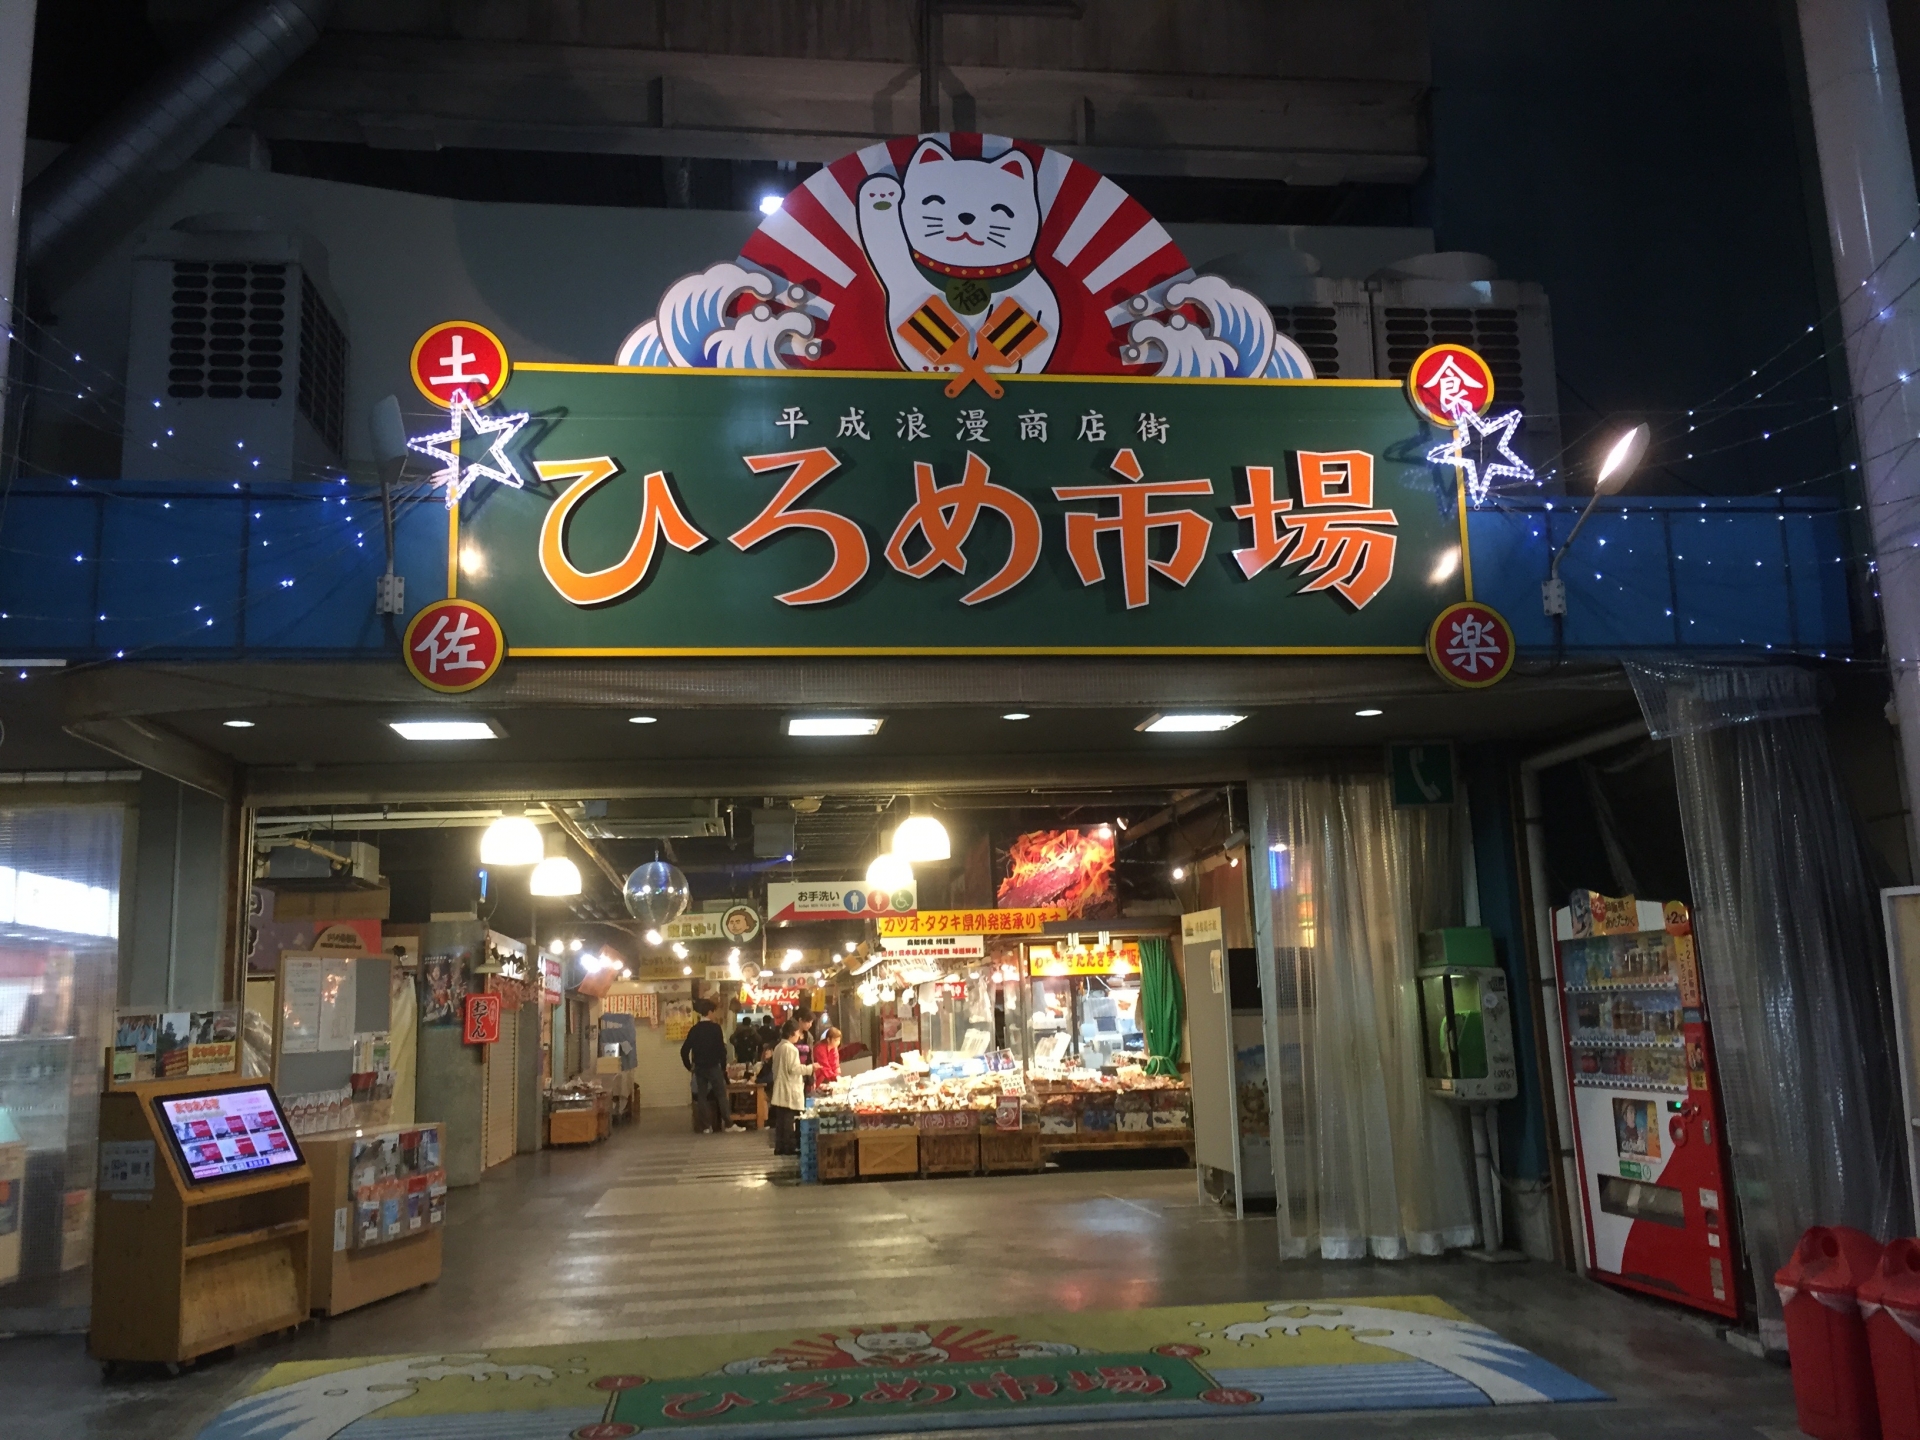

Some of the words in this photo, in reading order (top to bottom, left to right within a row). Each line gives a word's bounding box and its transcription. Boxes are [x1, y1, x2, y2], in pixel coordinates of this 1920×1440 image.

[429, 335, 490, 385] 土
[1423, 354, 1484, 417] 食
[774, 405, 1172, 445] 平成浪漫商店街
[538, 446, 1399, 612] ひろめ市場
[414, 614, 485, 674] 佐
[1446, 616, 1500, 673] 楽
[798, 890, 840, 902] お手洗い
[662, 1365, 1170, 1420] ひろめ市場
[913, 1366, 1006, 1378] MARKET
